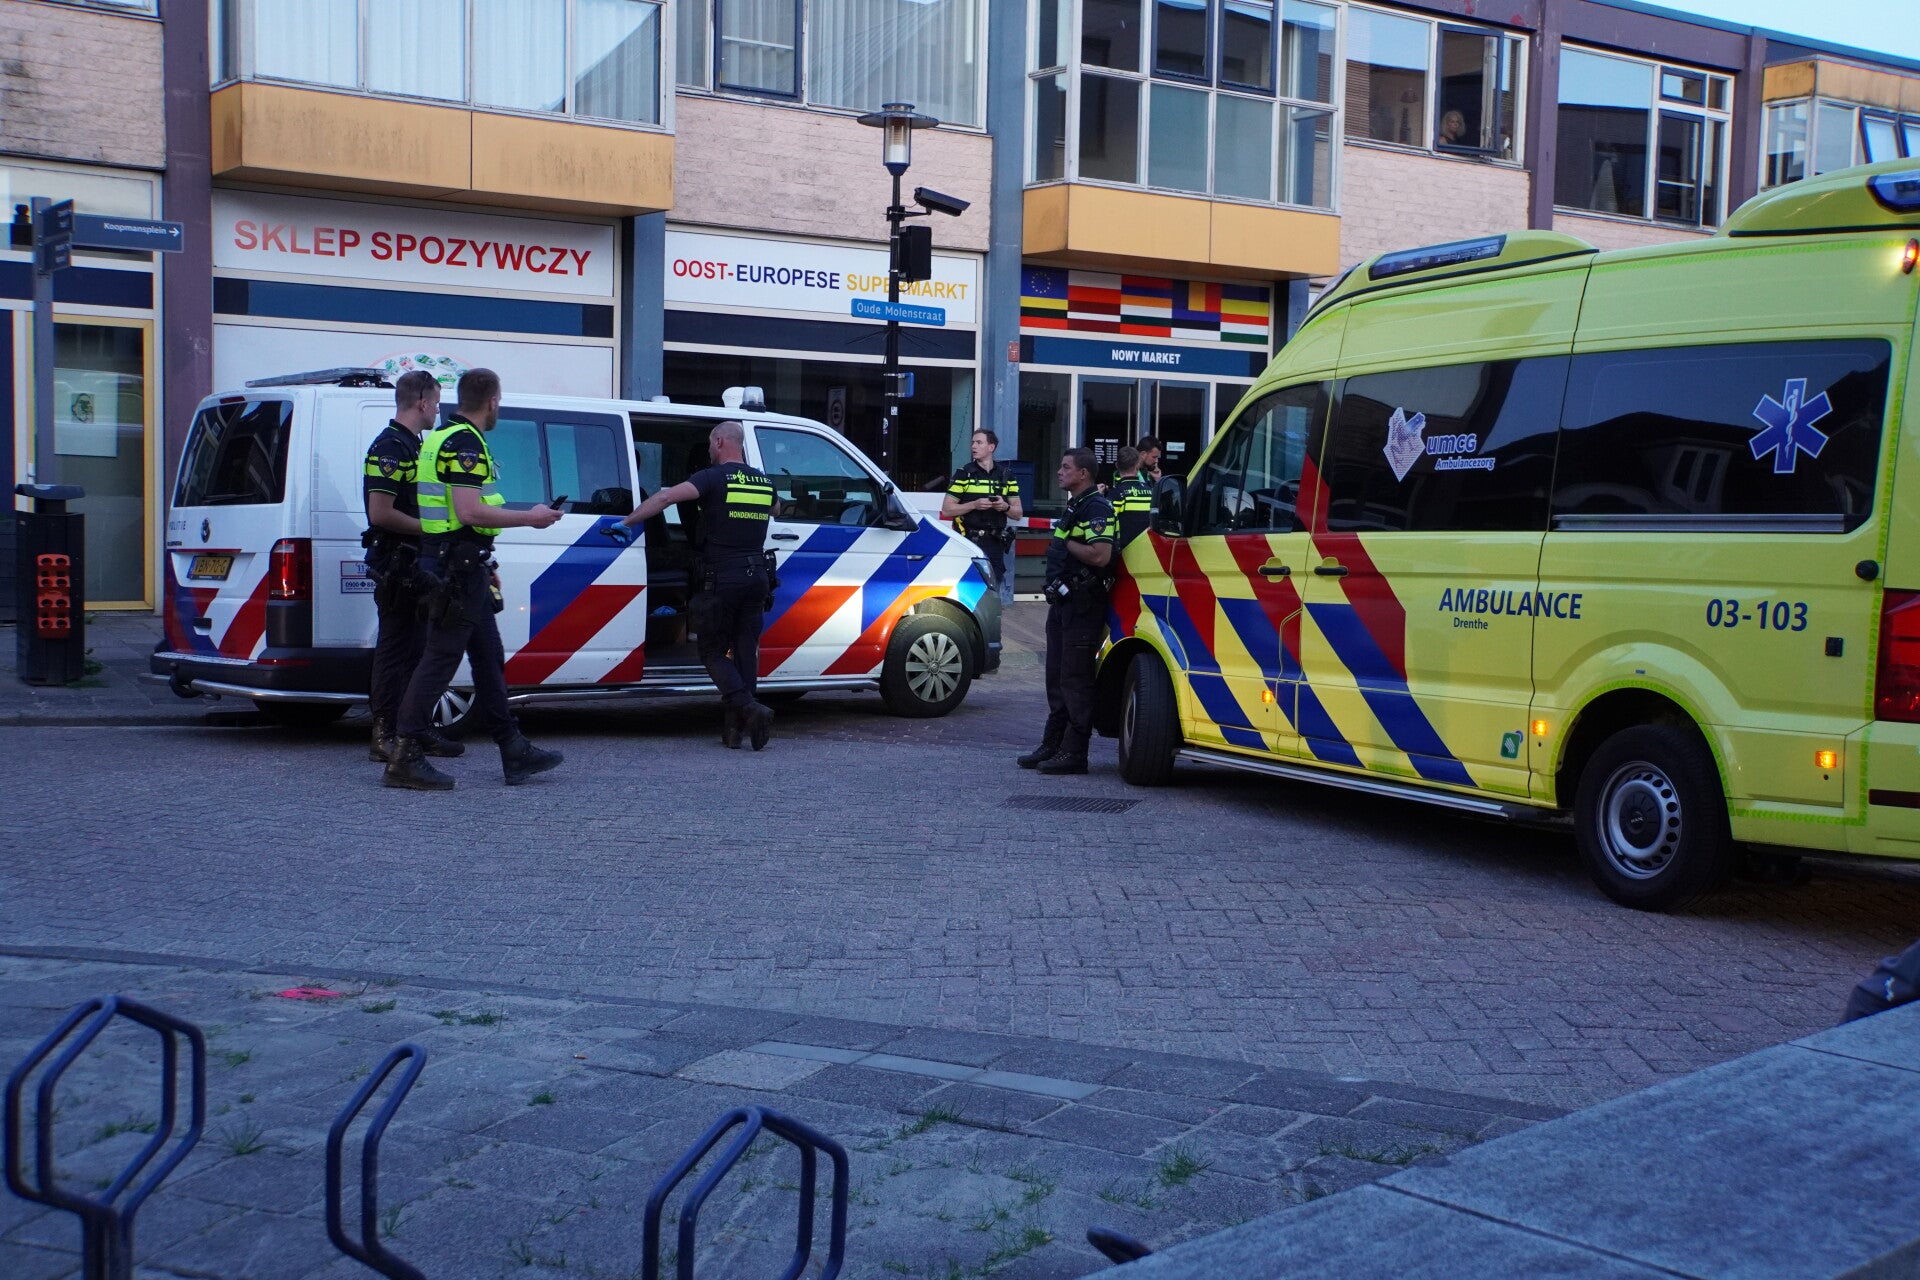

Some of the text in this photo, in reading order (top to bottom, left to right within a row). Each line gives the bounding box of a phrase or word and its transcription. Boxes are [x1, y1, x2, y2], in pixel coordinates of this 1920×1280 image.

[103, 222, 167, 236] Koopmansplein
[234, 219, 592, 277] SKLEP SPOZYWCZY
[672, 259, 840, 290] OOST-EUROPESE
[856, 302, 943, 322] Oude Molenstraat
[1111, 349, 1181, 365] NOWY MARKET
[1434, 457, 1496, 471] Ambulancezorg
[1438, 587, 1583, 620] AMBULANCE
[1453, 616, 1489, 630] Drenthe
[1705, 598, 1809, 632] 03-103
